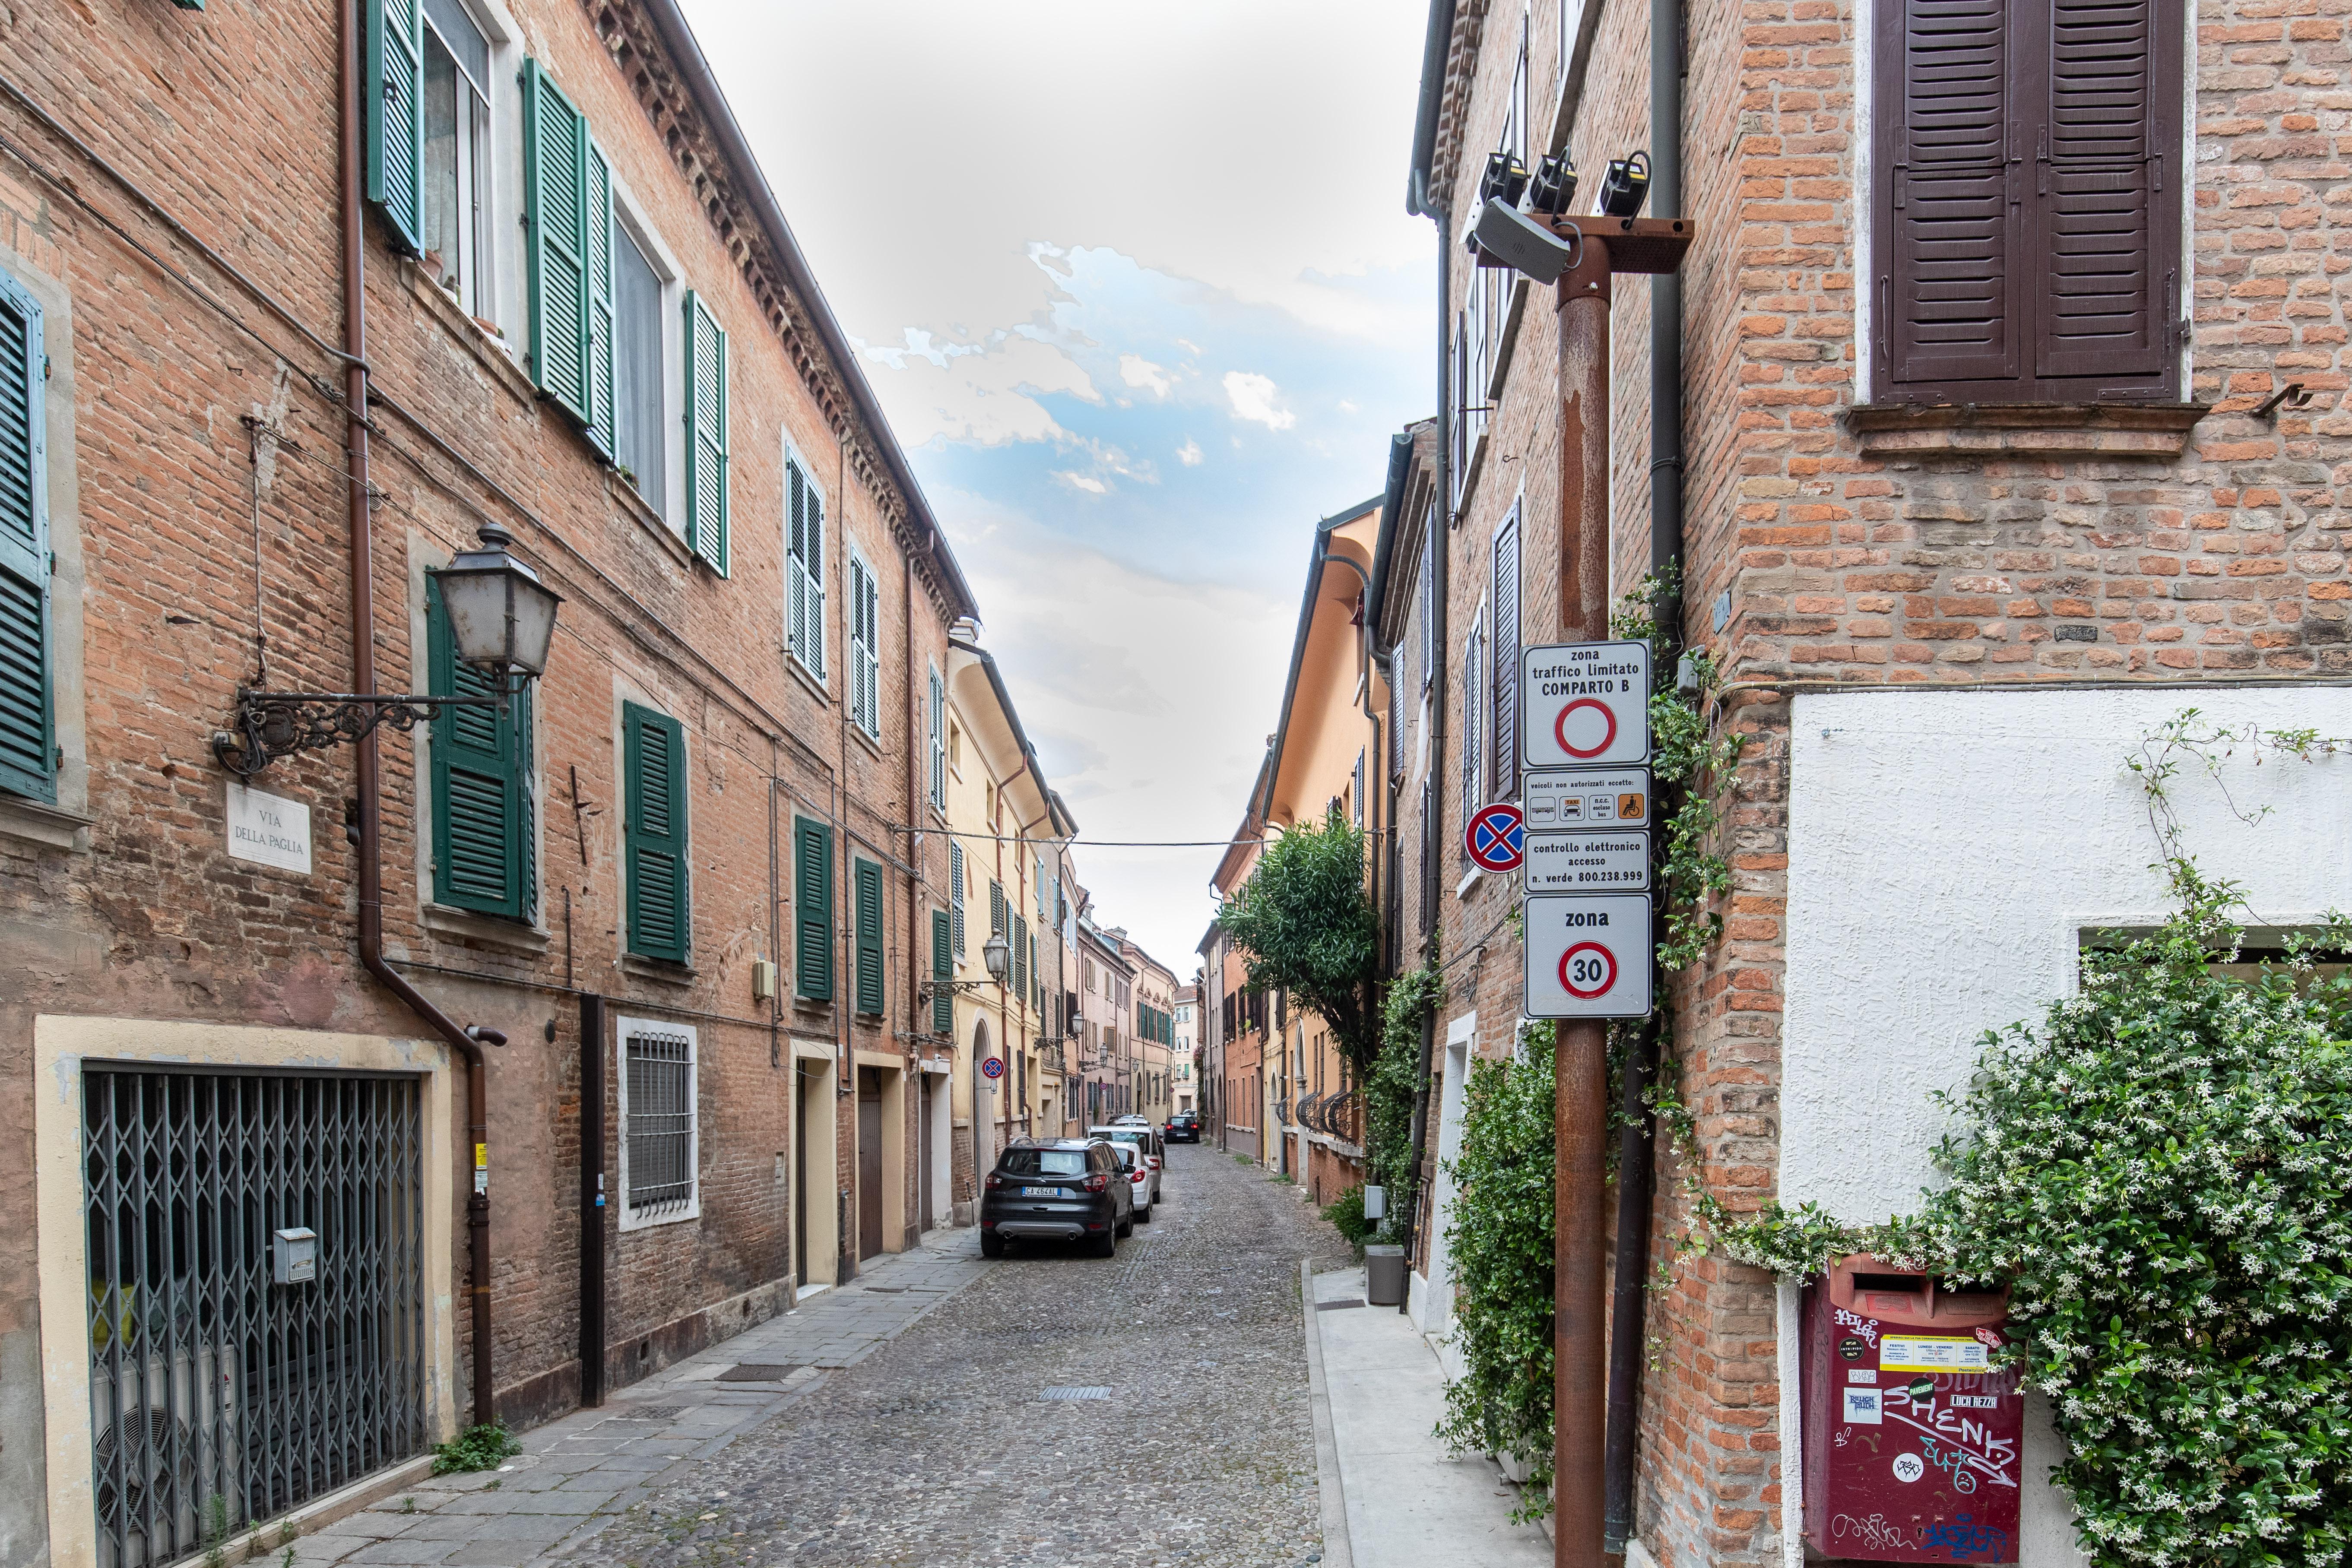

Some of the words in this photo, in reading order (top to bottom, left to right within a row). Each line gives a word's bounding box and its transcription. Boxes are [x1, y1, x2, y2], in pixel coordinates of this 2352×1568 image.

[1571, 651, 1599, 661] zona
[1532, 665, 1581, 679] traffico
[1588, 662, 1639, 676] limitato
[1542, 680, 1613, 696] COMPARTO
[1622, 679, 1629, 692] B
[260, 811, 282, 827] VIA
[235, 825, 266, 845] DELLA
[269, 834, 304, 855] PAGLIA
[1534, 843, 1579, 853] controllo
[1585, 841, 1640, 852] elettronico
[1568, 858, 1606, 866] accesso
[1546, 873, 1573, 883] verde
[1579, 871, 1642, 882] 800.238.999
[1566, 912, 1609, 927] zona
[1573, 958, 1602, 982] 30
[1909, 1383, 1934, 1396] PAVEMENT
[1951, 1395, 1971, 1407] LUCA
[1973, 1397, 1996, 1408] REZZA
